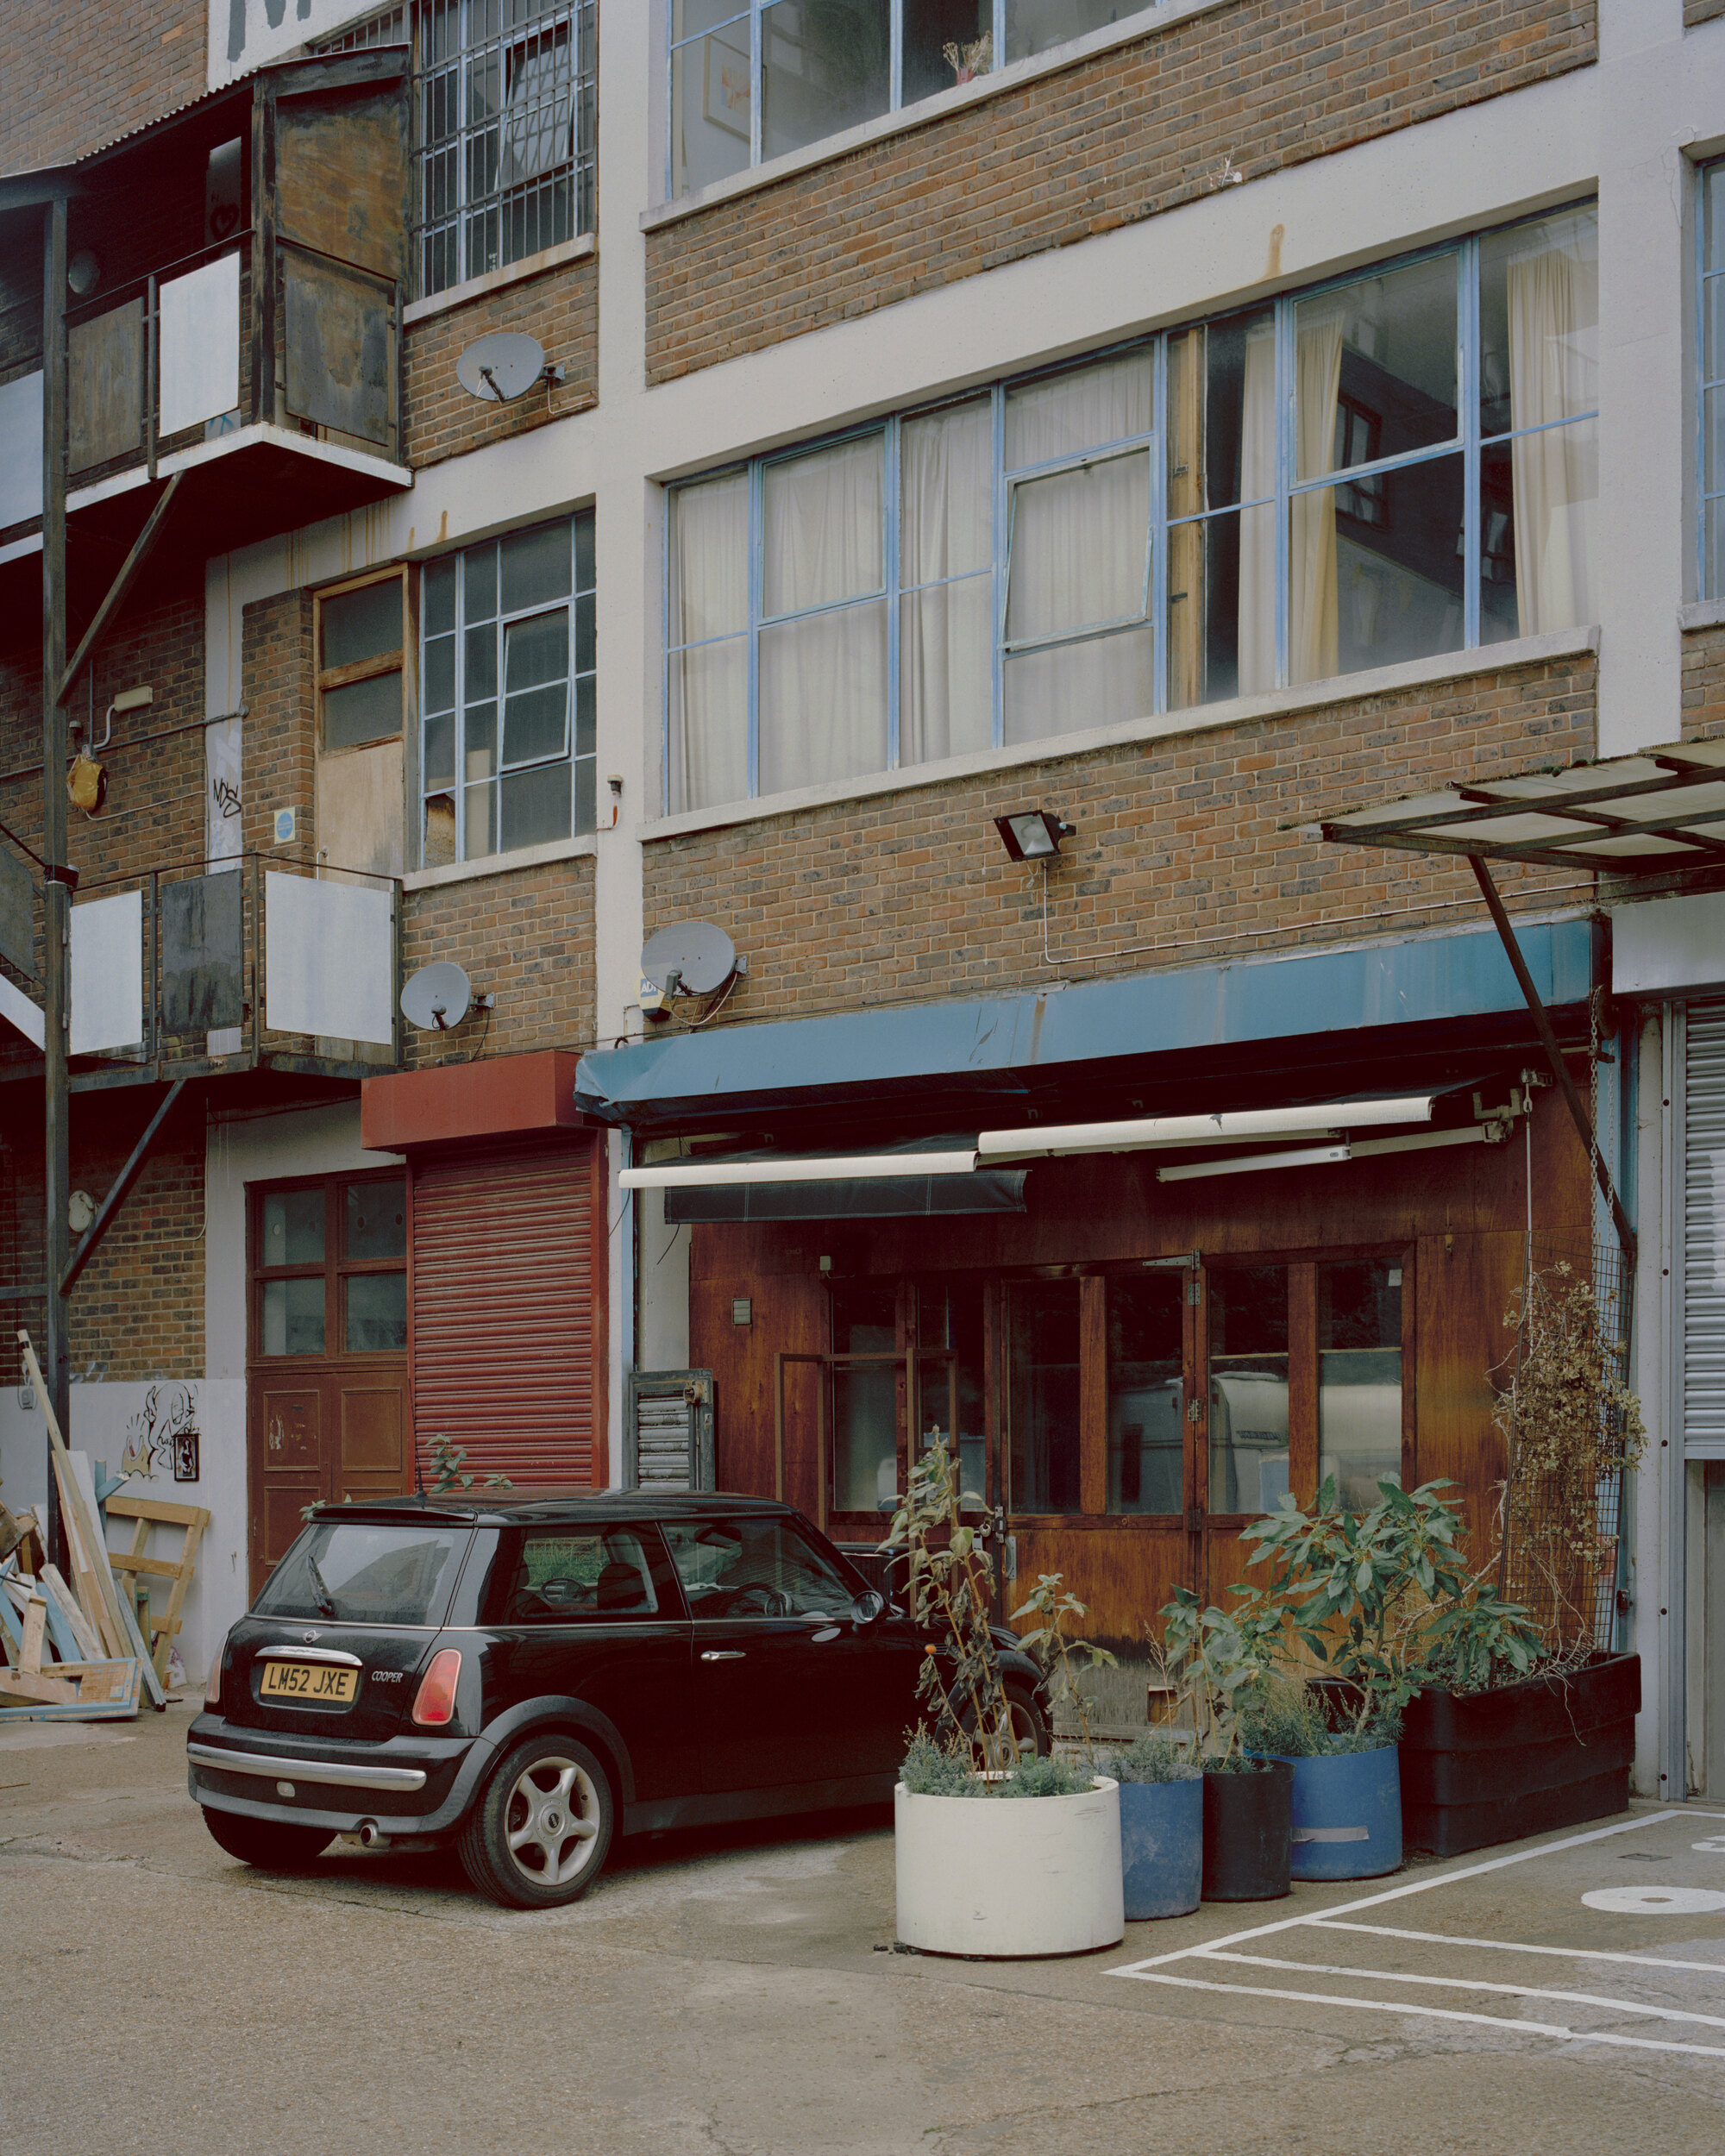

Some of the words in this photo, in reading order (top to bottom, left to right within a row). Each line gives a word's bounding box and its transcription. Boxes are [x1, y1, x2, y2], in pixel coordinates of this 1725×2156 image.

[267, 1666, 310, 1692] LM52
[313, 1670, 349, 1695] JXE
[371, 1670, 404, 1683] COOPER
